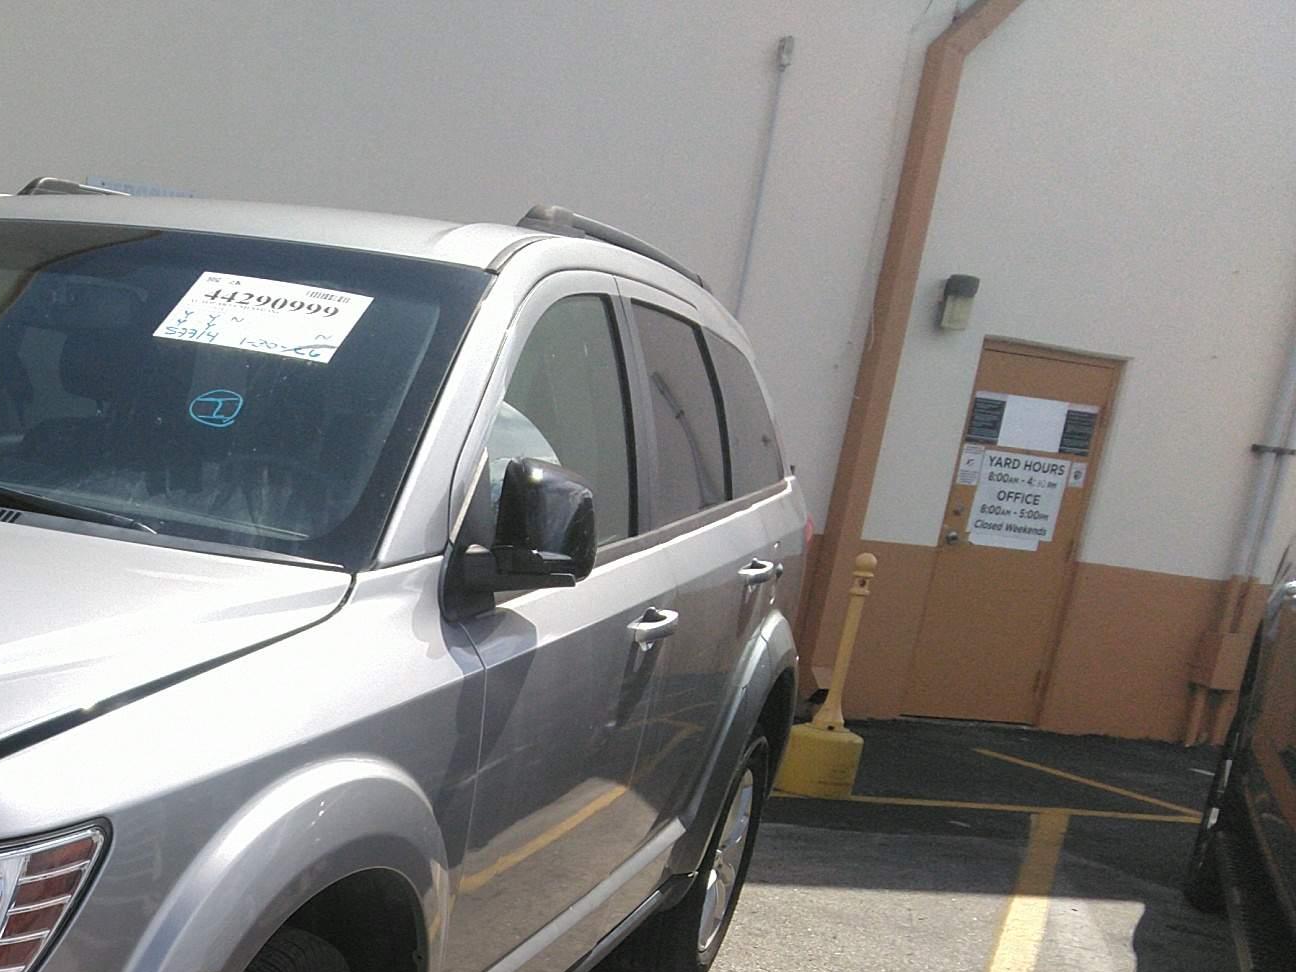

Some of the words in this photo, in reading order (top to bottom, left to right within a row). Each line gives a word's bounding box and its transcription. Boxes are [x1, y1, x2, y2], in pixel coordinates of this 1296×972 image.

[204, 289, 340, 318] 44290999
[988, 455, 1021, 470] YARD
[1023, 460, 1066, 476] HOURS
[996, 490, 1041, 506] OFFICE
[974, 519, 1003, 531] Closed
[1005, 522, 1047, 536] Weekends
